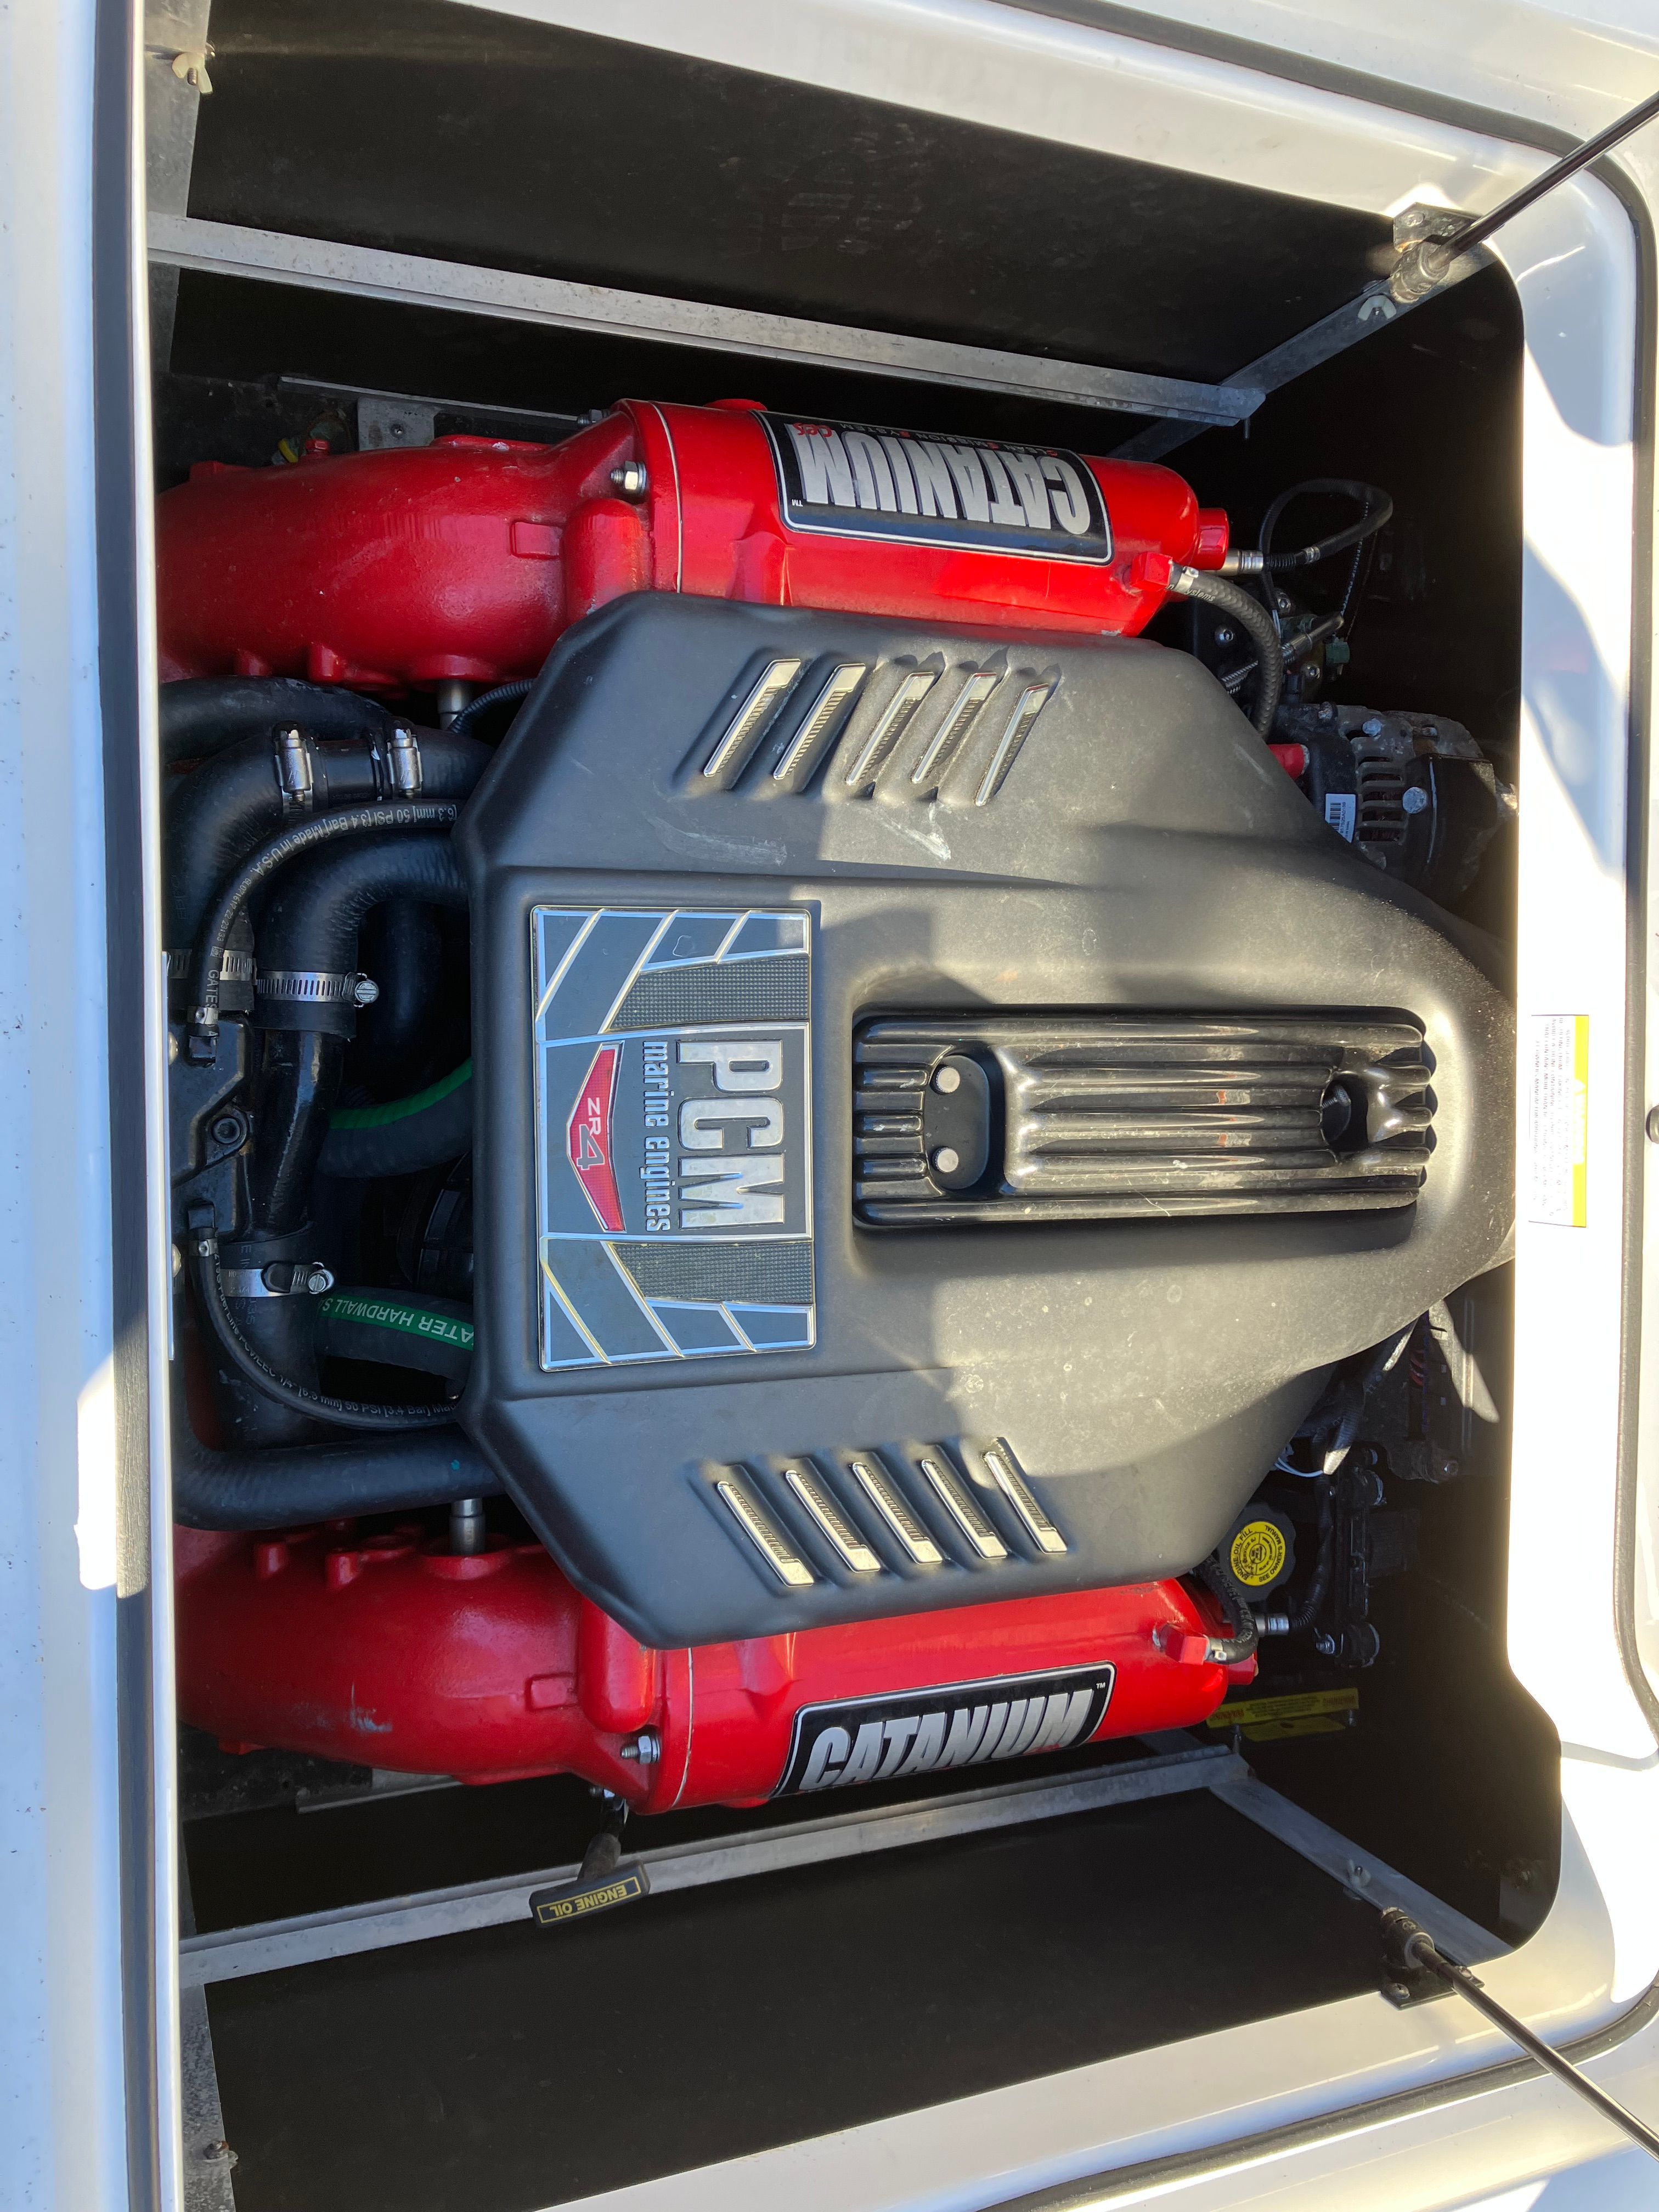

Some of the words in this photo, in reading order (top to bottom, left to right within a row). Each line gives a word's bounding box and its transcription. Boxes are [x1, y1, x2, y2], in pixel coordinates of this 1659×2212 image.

[784, 424, 1092, 535] CATANIUM
[351, 810, 372, 829] [3.4
[374, 810, 393, 826] PSI
[397, 809, 410, 823] 50
[413, 805, 435, 822] mm]
[292, 824, 324, 845] Made
[322, 816, 349, 836] Bar]
[643, 1041, 675, 1127] marine
[676, 1040, 785, 1231] PCM
[640, 1136, 675, 1232] engines
[335, 1298, 415, 1327] HARDWALL
[418, 1315, 474, 1344] ATER
[362, 1405, 381, 1415] PSI
[383, 1405, 405, 1418] [3.4
[408, 1406, 431, 1417] Bar]
[1240, 1528, 1253, 1541] FILL
[1265, 1525, 1282, 1545] MANUAL
[1233, 1542, 1242, 1555] OIL
[1233, 1557, 1250, 1580] ENGINE
[1270, 1546, 1283, 1575] OWNER'S
[1259, 1573, 1270, 1582] SEE
[799, 1689, 1096, 1790] CATANIUM
[574, 1884, 627, 1911] ENGINE
[549, 1902, 573, 1917] OIL
